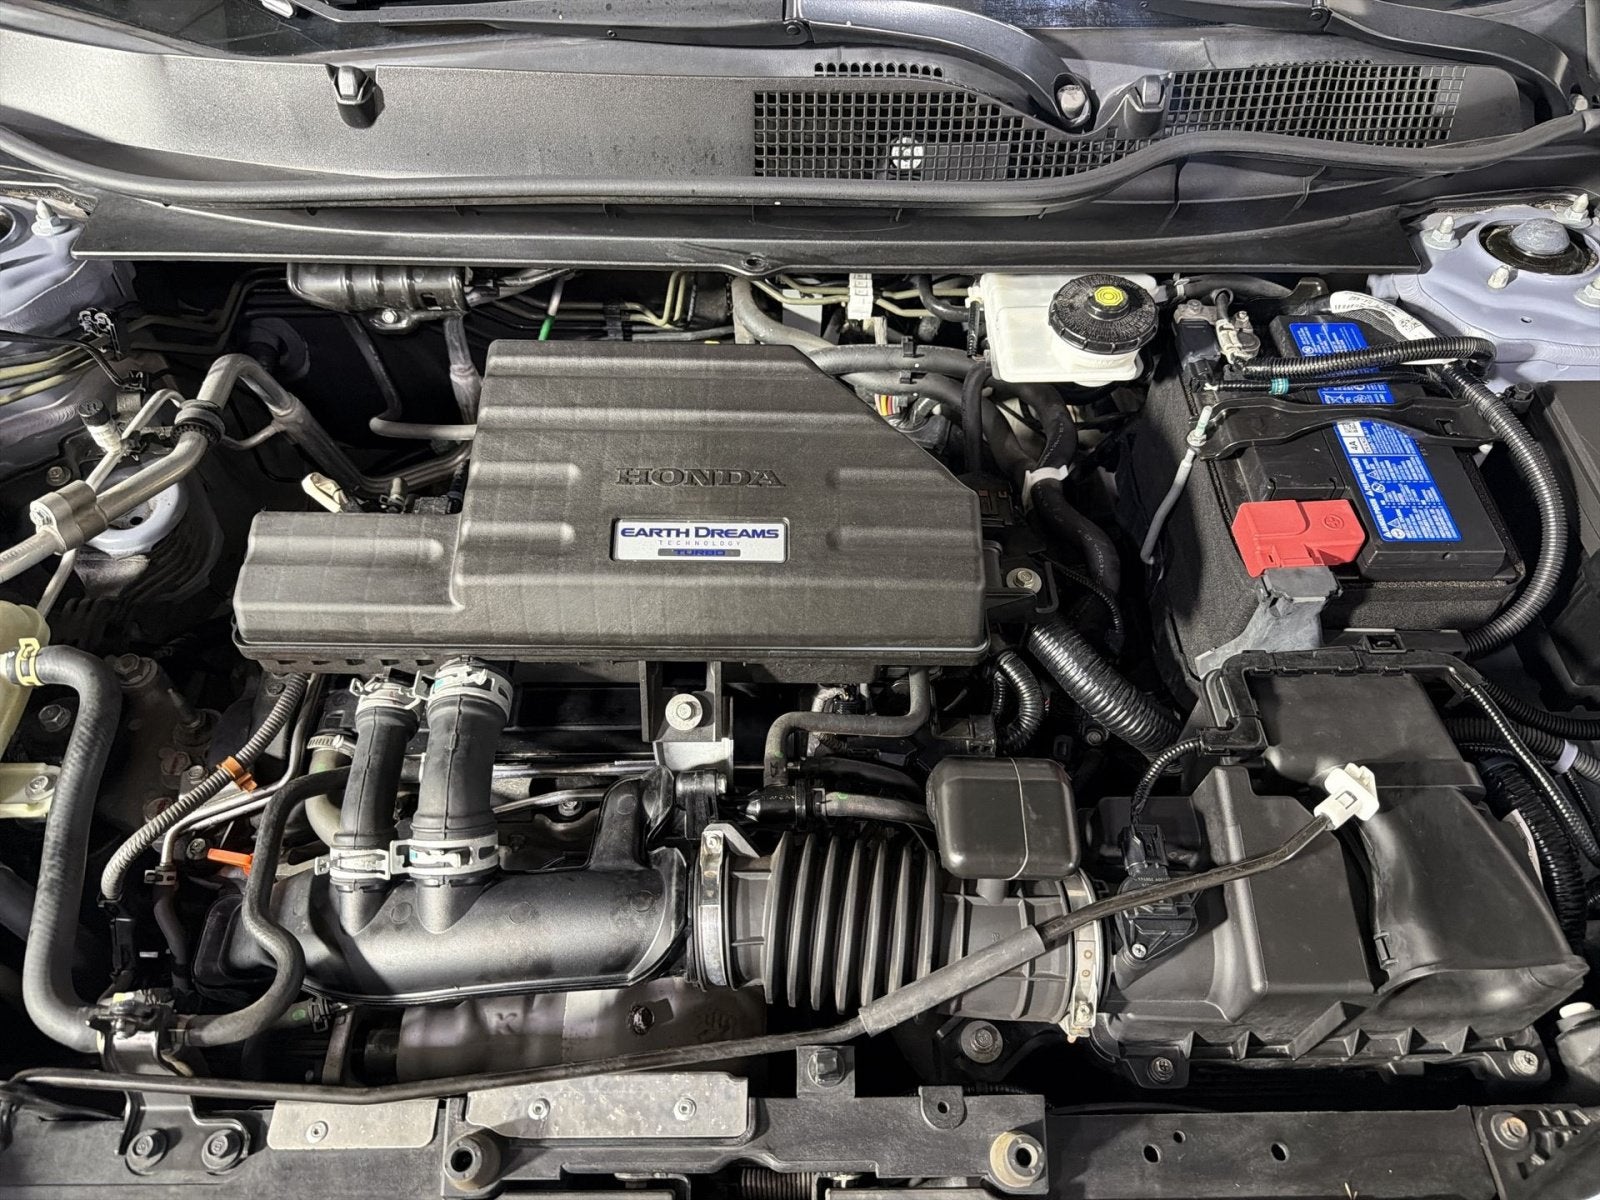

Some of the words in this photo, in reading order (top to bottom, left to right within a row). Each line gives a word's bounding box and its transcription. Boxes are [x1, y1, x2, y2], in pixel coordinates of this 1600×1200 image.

[616, 468, 786, 487] HONDA
[620, 527, 690, 538] EARTH
[694, 526, 779, 539] DREAMS
